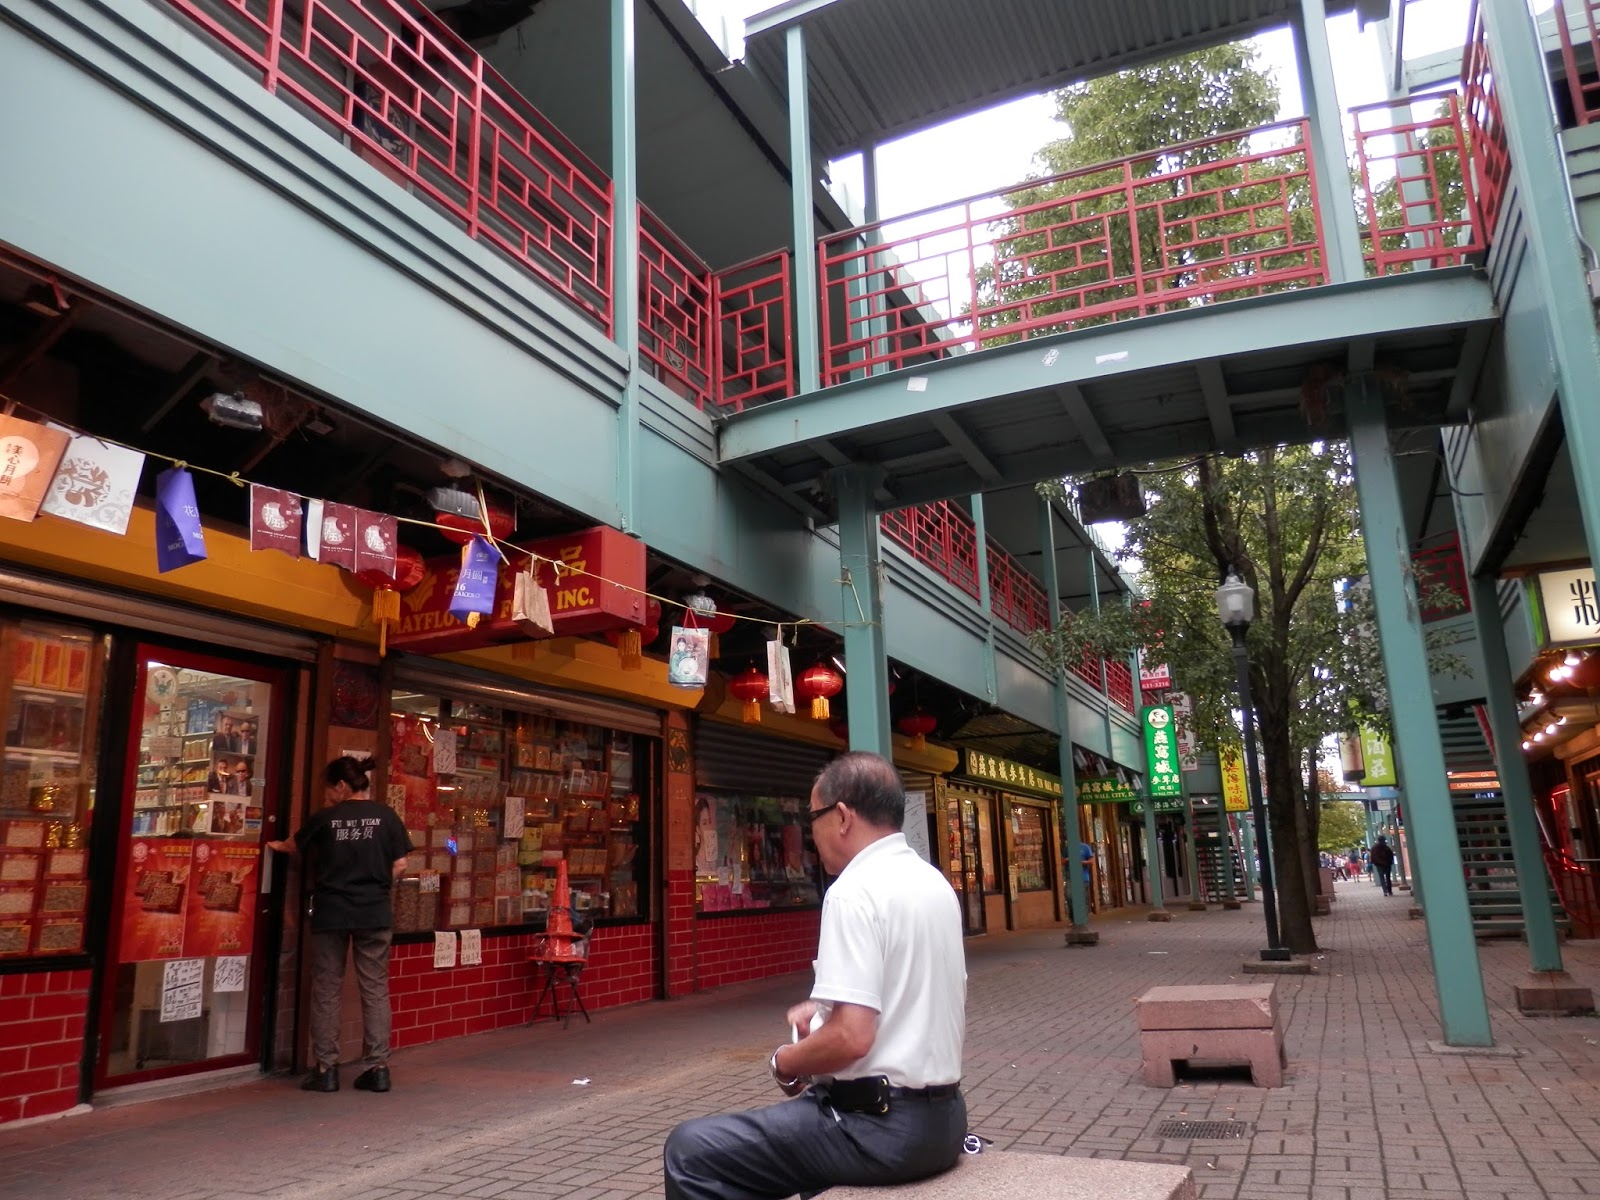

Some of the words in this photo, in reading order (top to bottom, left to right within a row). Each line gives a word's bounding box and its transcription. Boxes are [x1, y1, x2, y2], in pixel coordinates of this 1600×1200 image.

[556, 587, 594, 610] INC.
[331, 820, 343, 828] FU
[346, 819, 358, 828] WU
[361, 818, 381, 827] YUAN
[336, 826, 374, 841] 服务员
